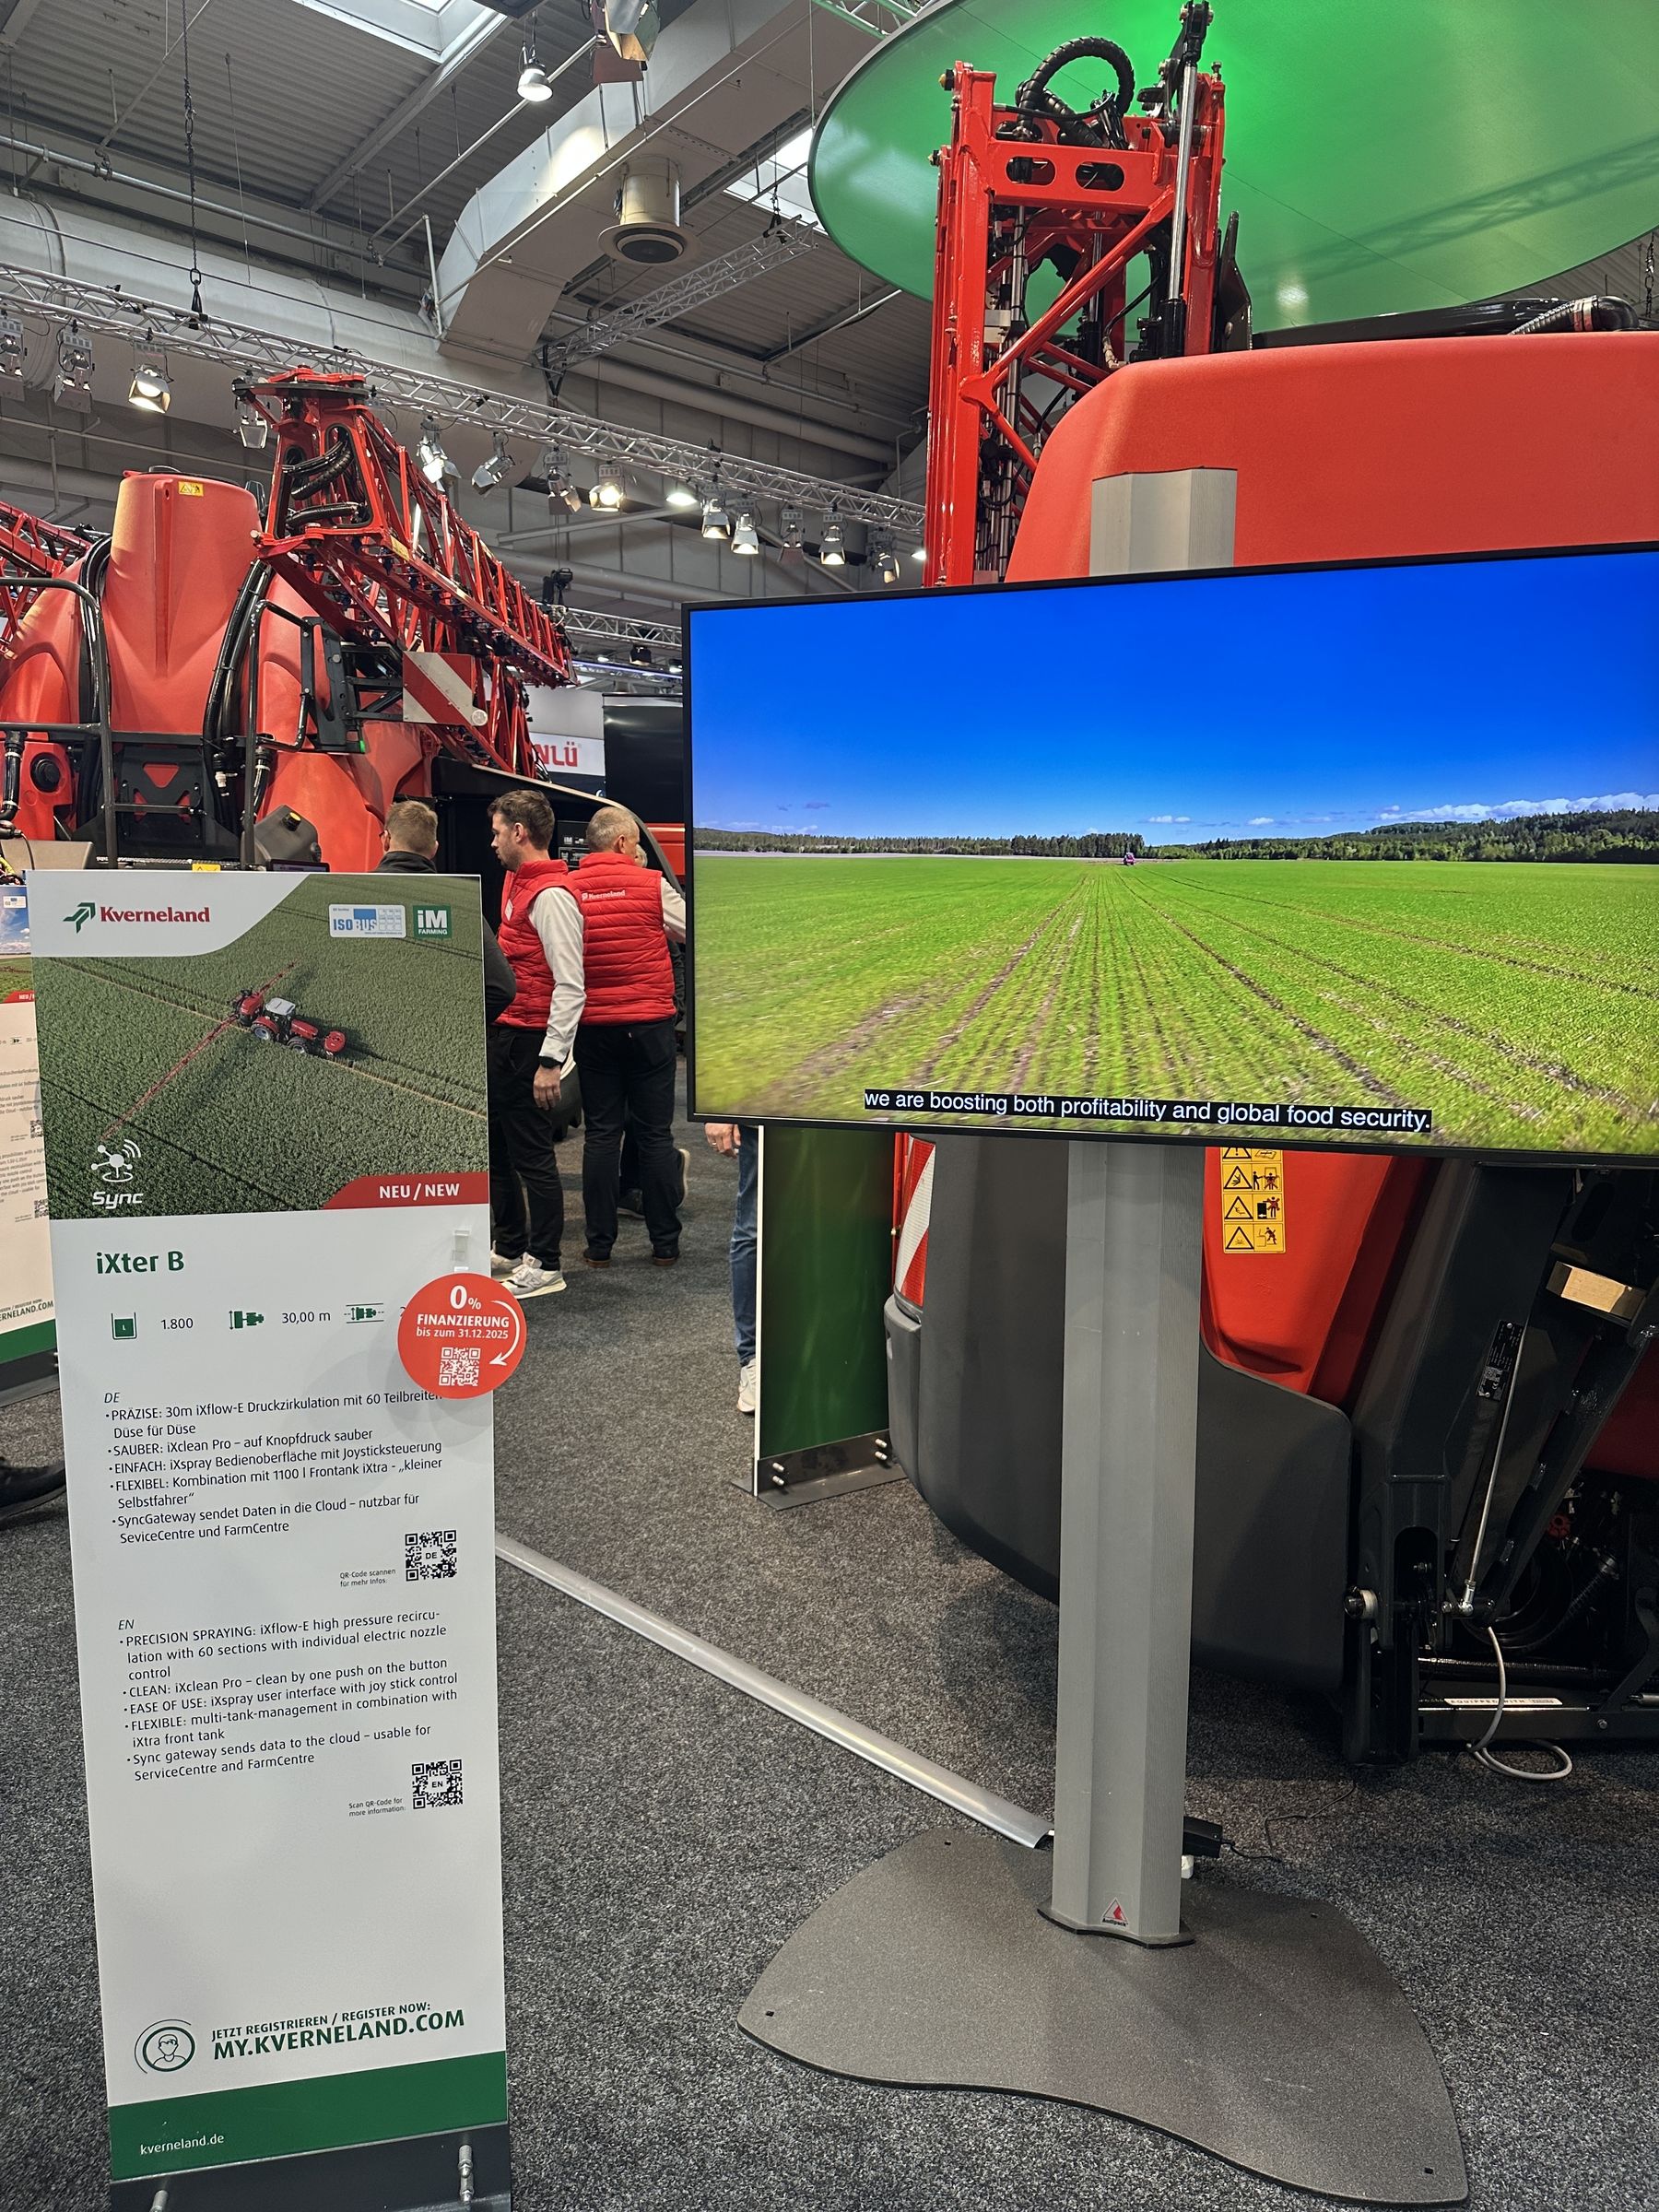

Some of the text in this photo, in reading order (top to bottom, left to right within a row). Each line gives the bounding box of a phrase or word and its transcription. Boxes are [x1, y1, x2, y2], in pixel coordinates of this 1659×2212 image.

[100, 906, 210, 923] Kverneland
[418, 910, 447, 928] iM
[865, 1091, 1430, 1133] we are boosting both profitability and global food security.
[92, 1191, 144, 1209] Sync
[379, 1185, 410, 1199] NEU
[426, 1182, 461, 1197] NEW
[96, 1251, 184, 1274] iXter B
[160, 1317, 194, 1330] 1.800
[281, 1311, 331, 1324] 30,00 m
[417, 1313, 510, 1328] FINANZIERUNG
[416, 1327, 509, 1340] bis zum 31.12.2025
[103, 1392, 121, 1404] DE
[112, 1406, 162, 1421] PRÄZISE:
[165, 1406, 193, 1418] 30m
[195, 1402, 244, 1417] iXflow-E
[247, 1396, 340, 1413] Druckzirkulation
[343, 1394, 363, 1406] mit
[366, 1393, 381, 1406] 60
[113, 1423, 196, 1439] Düse für Düse
[113, 1428, 373, 1457] SAUBER: iXclean Pro auf Knopfdruck sauber
[115, 1441, 442, 1475] EINFACH: iXspray Bedienoberfläche mit Joysticksteuerung
[116, 1477, 170, 1492] FLEXIBEL:
[172, 1472, 247, 1488] Kombination
[250, 1469, 270, 1483] mit
[272, 1468, 300, 1481] 1100
[310, 1463, 359, 1478] Frontank
[362, 1462, 388, 1475] iXtra
[398, 1458, 442, 1474] „kleiner
[117, 1491, 194, 1510] Selbstfahrer“
[118, 1493, 420, 1529] SyncGateway sendet Daten in die Cloud nutzbar für
[120, 1522, 289, 1545] SeviceCentre und FarmCentre
[118, 1618, 135, 1630] EN
[126, 1611, 441, 1647] PRECISION SPRAYING: iXflow-E high pressure recircu-
[127, 1625, 447, 1665] lation with 60 sections with individual electric nozzle
[128, 1665, 171, 1681] control
[129, 1684, 171, 1698] CLEAN:
[174, 1680, 218, 1694] iXclean
[222, 1677, 242, 1689] Pro
[255, 1673, 288, 1686] clean
[291, 1670, 306, 1685] by
[309, 1670, 332, 1681] one
[335, 1665, 364, 1681] push
[367, 1665, 382, 1676] on
[386, 1661, 406, 1674] the
[409, 1659, 448, 1672] button
[130, 1672, 457, 1715] EASE OF USE: iXspray user interface with joy stick control
[132, 1688, 457, 1732] FLEXIBLE: multi-tank-management in combination with
[132, 1727, 226, 1748] iXtra front tank
[133, 1753, 161, 1767] Sync
[165, 1747, 218, 1764] gateway
[220, 1741, 256, 1756] sends
[259, 1740, 286, 1752] data
[289, 1738, 302, 1748] to
[305, 1735, 325, 1747] the
[329, 1731, 360, 1745] cloud
[373, 1726, 411, 1740] usable
[415, 1724, 431, 1736] for
[135, 1754, 315, 1782] ServiceCentre and FarmCentre
[211, 2027, 242, 2042] JETZT
[246, 2015, 329, 2036] REGISTRIEREN
[342, 2006, 395, 2023] REGISTER
[399, 2001, 431, 2014] NOW:
[214, 2009, 465, 2061] MY.KVERNELAND.COM
[140, 2132, 226, 2157] kverneland.de
